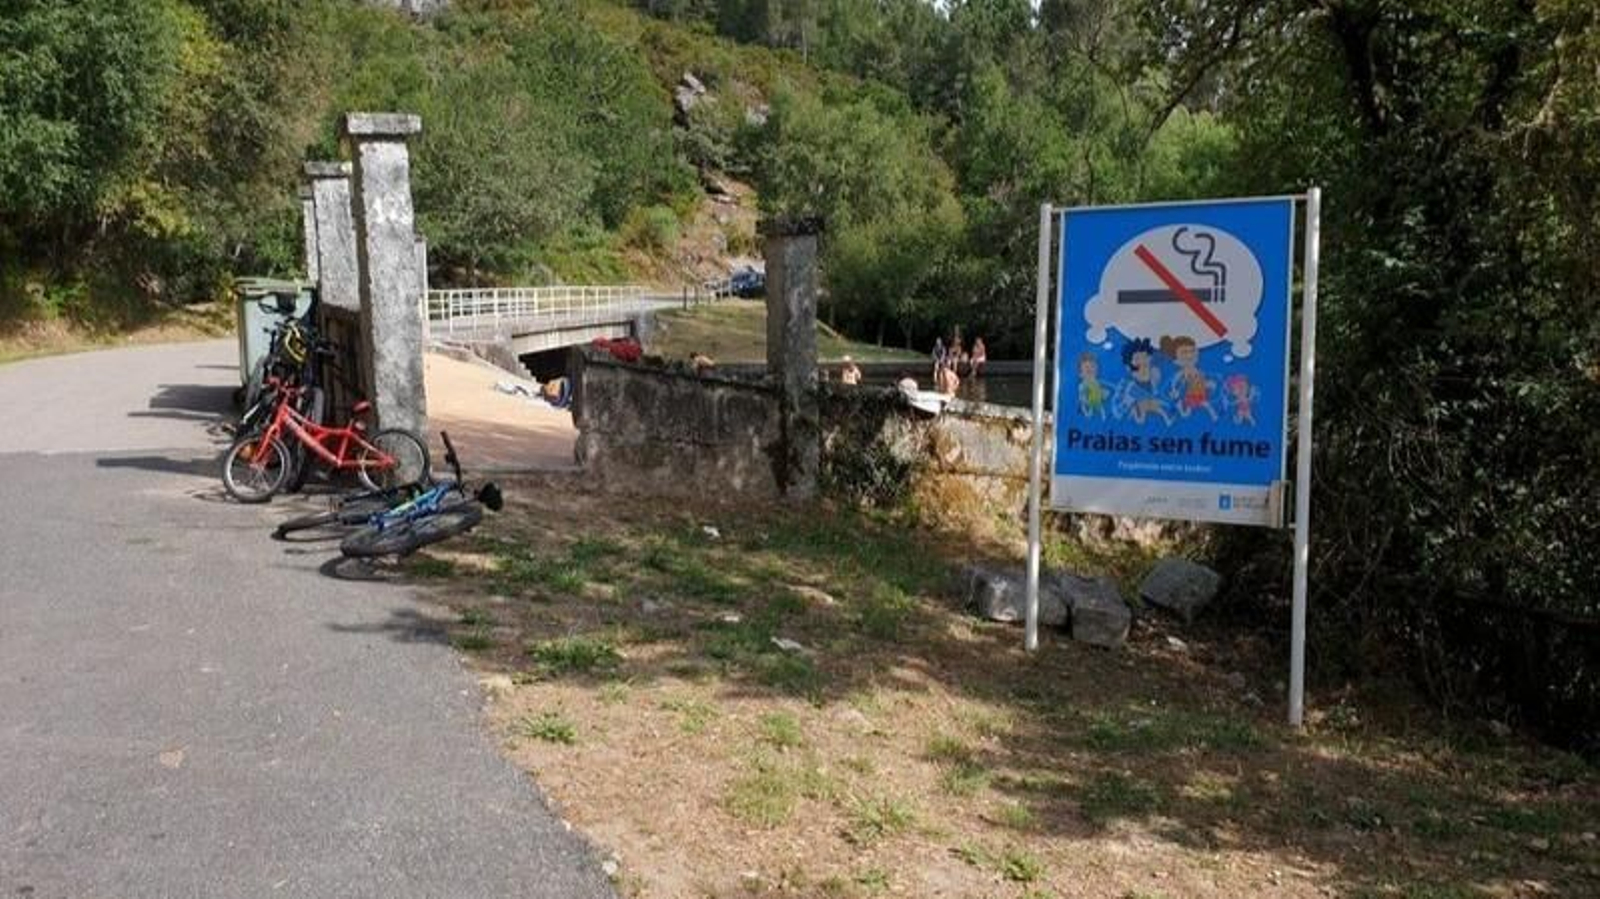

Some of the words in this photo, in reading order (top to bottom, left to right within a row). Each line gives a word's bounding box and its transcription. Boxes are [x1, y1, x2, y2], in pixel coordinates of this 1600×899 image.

[1067, 428, 1142, 452] Praias
[1149, 433, 1193, 455] sen
[1199, 431, 1271, 459] fume
